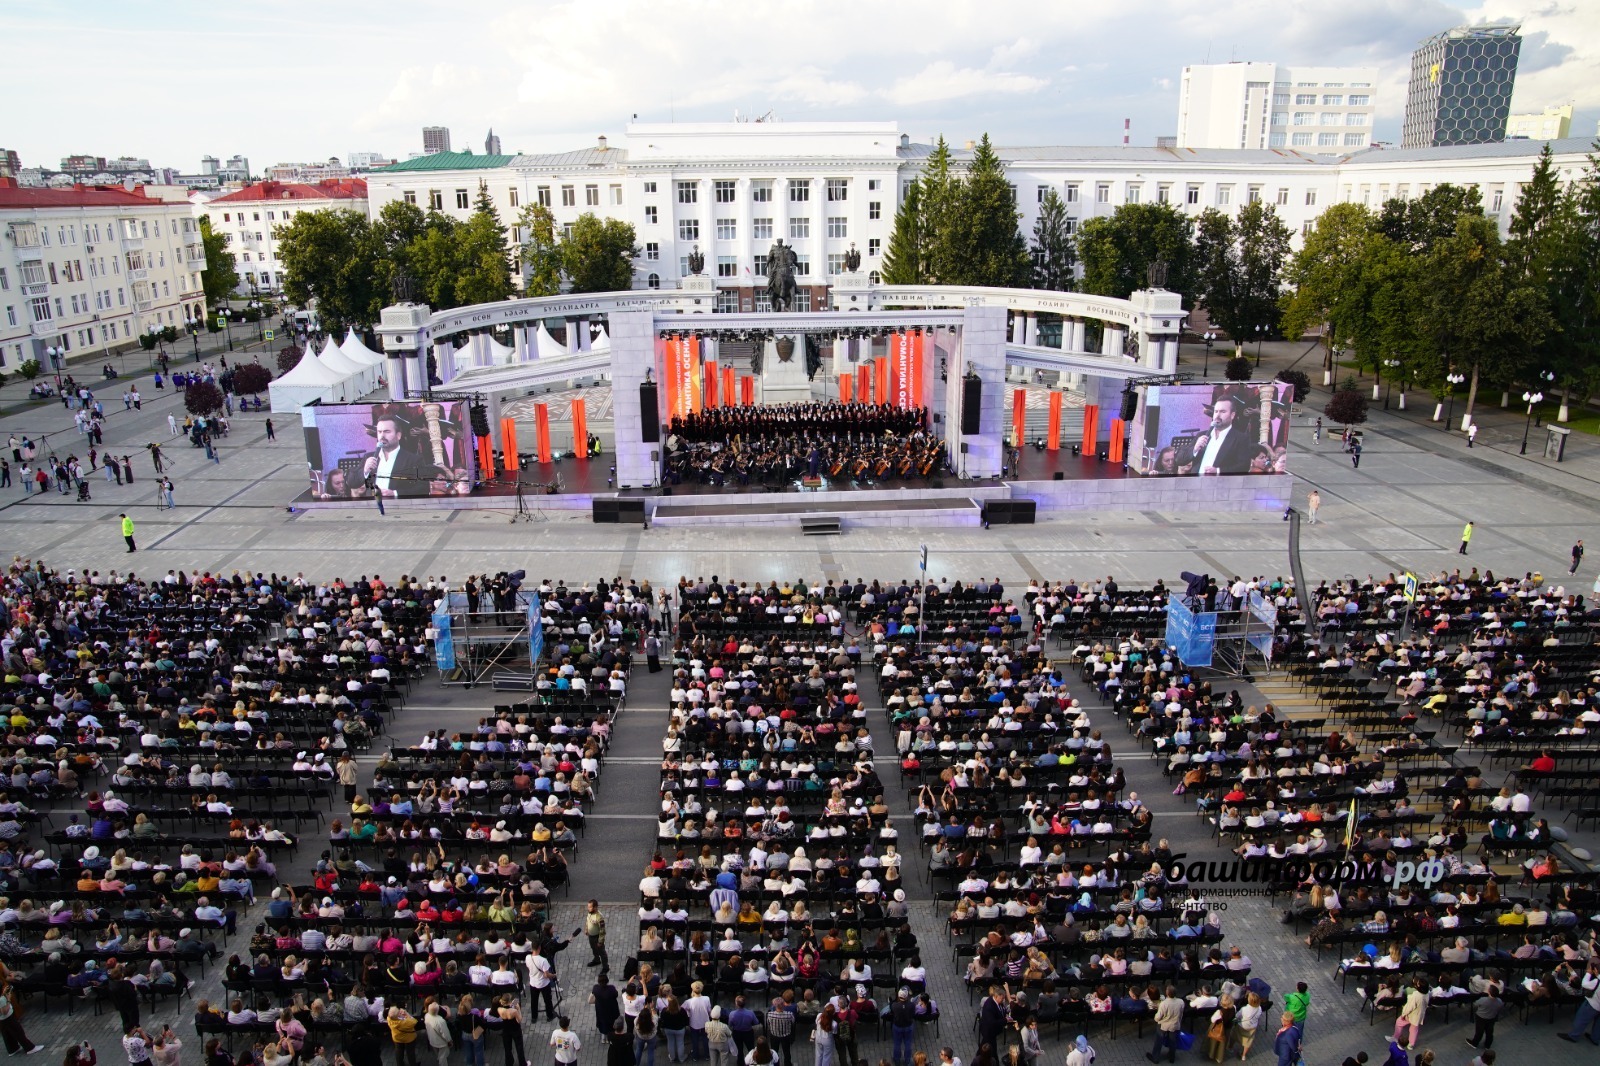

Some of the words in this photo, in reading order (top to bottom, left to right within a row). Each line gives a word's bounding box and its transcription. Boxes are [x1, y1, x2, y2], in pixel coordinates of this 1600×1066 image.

[1037, 300, 1070, 308] РОДИНУ
[683, 340, 691, 369] ОСЕНИ
[899, 336, 907, 389] РОМАНТИКА
[684, 371, 692, 413] МАНТИКА
